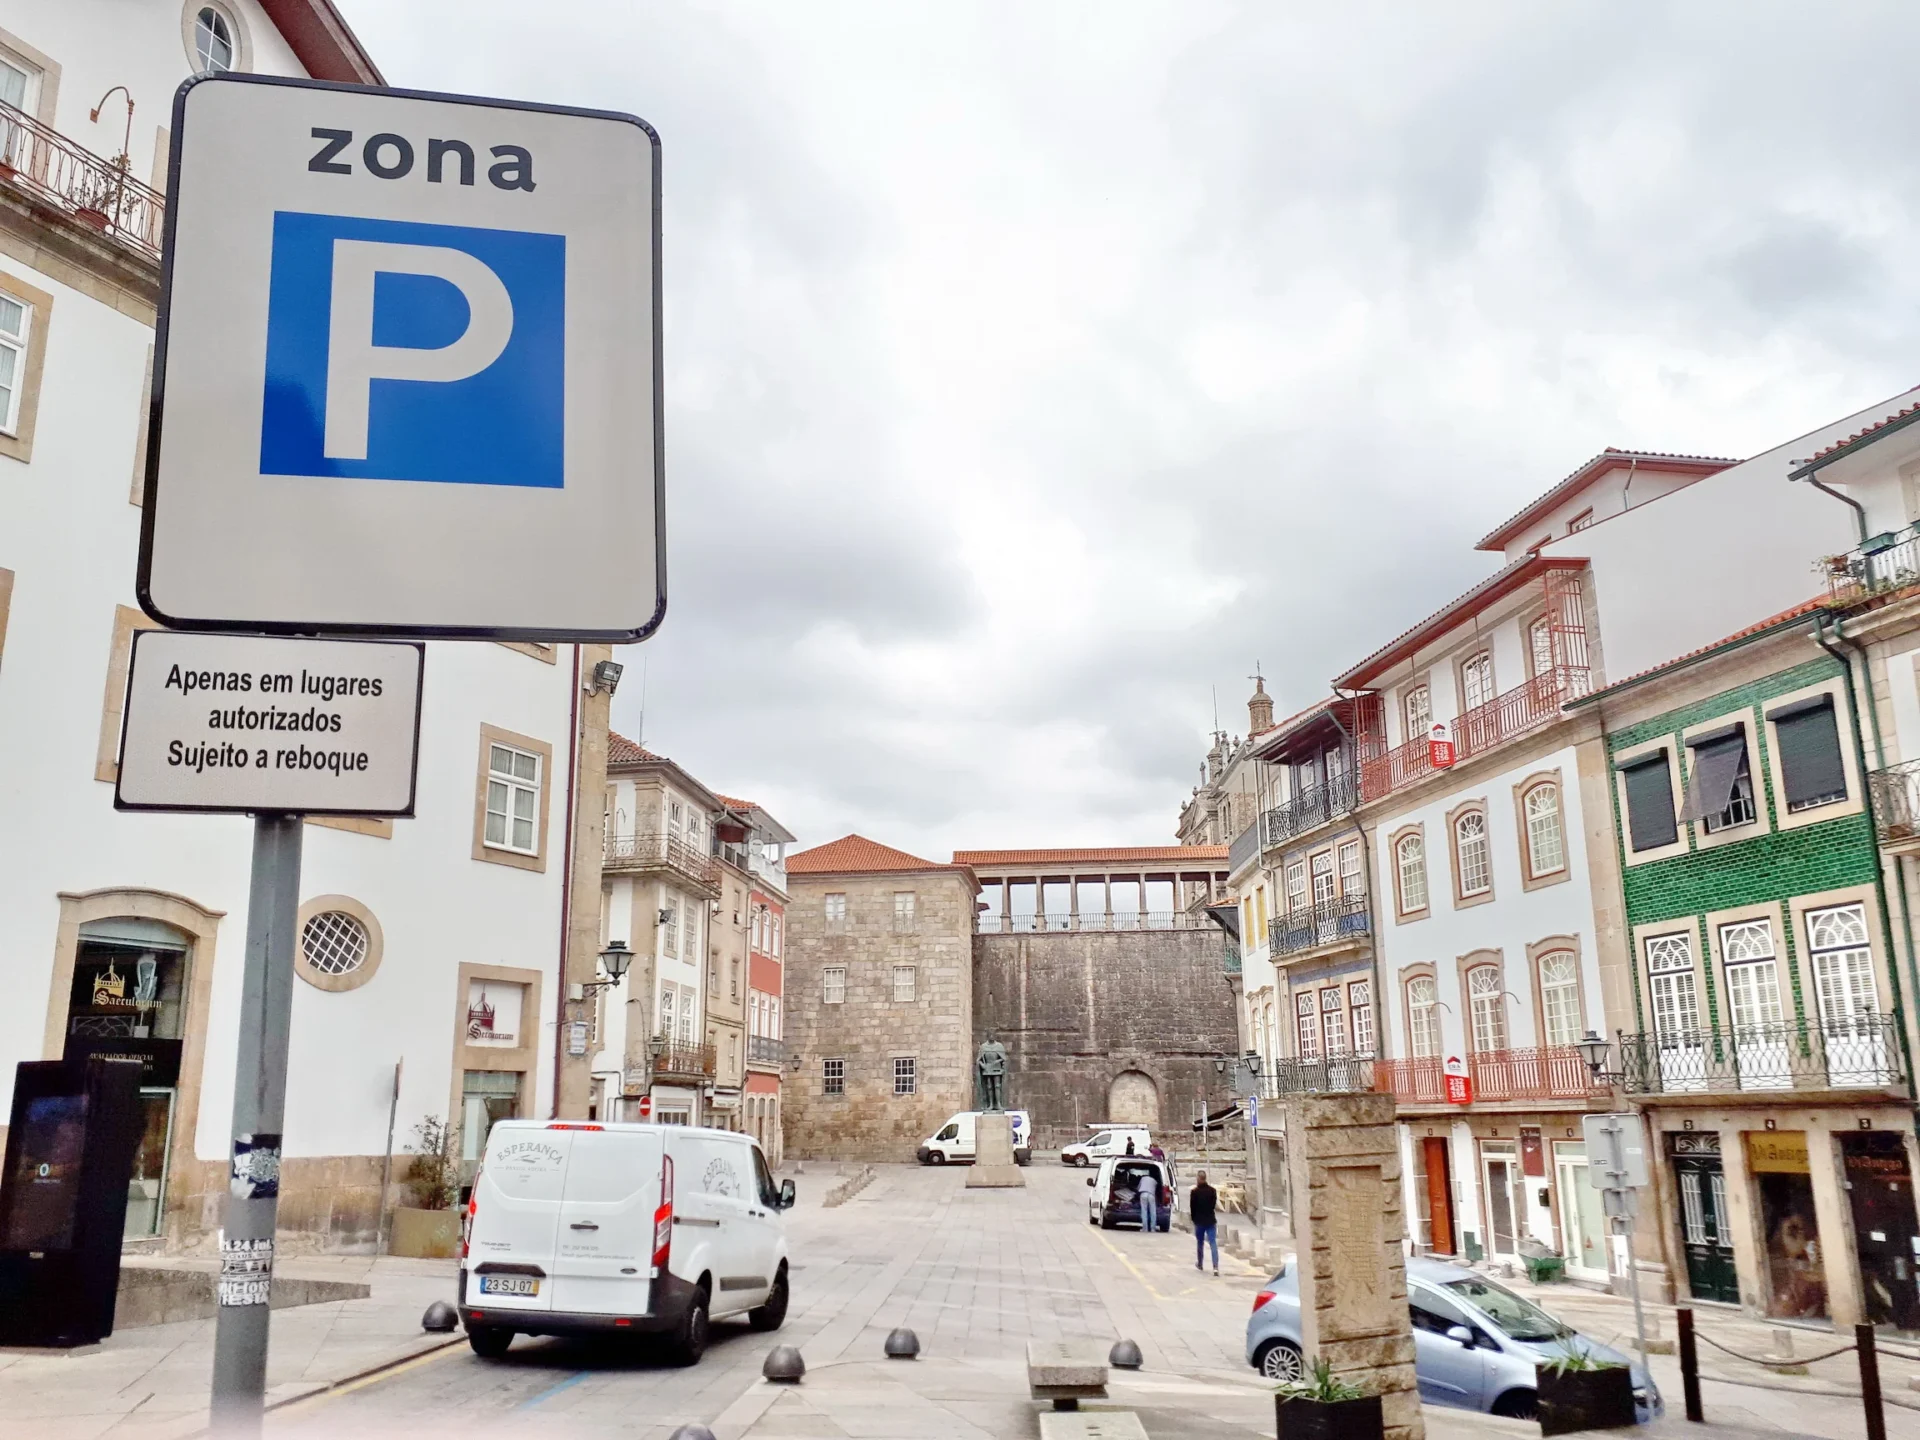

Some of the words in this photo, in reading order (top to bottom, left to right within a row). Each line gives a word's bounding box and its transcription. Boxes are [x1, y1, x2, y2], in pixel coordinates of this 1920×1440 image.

[307, 126, 538, 193] zona
[323, 238, 514, 460] P
[165, 664, 252, 696] Apenas
[259, 673, 293, 693] em
[301, 669, 383, 701] lugares
[208, 705, 342, 732] autorizados
[167, 739, 249, 773] Sujeito
[255, 749, 268, 768] a
[276, 744, 369, 777] reboque
